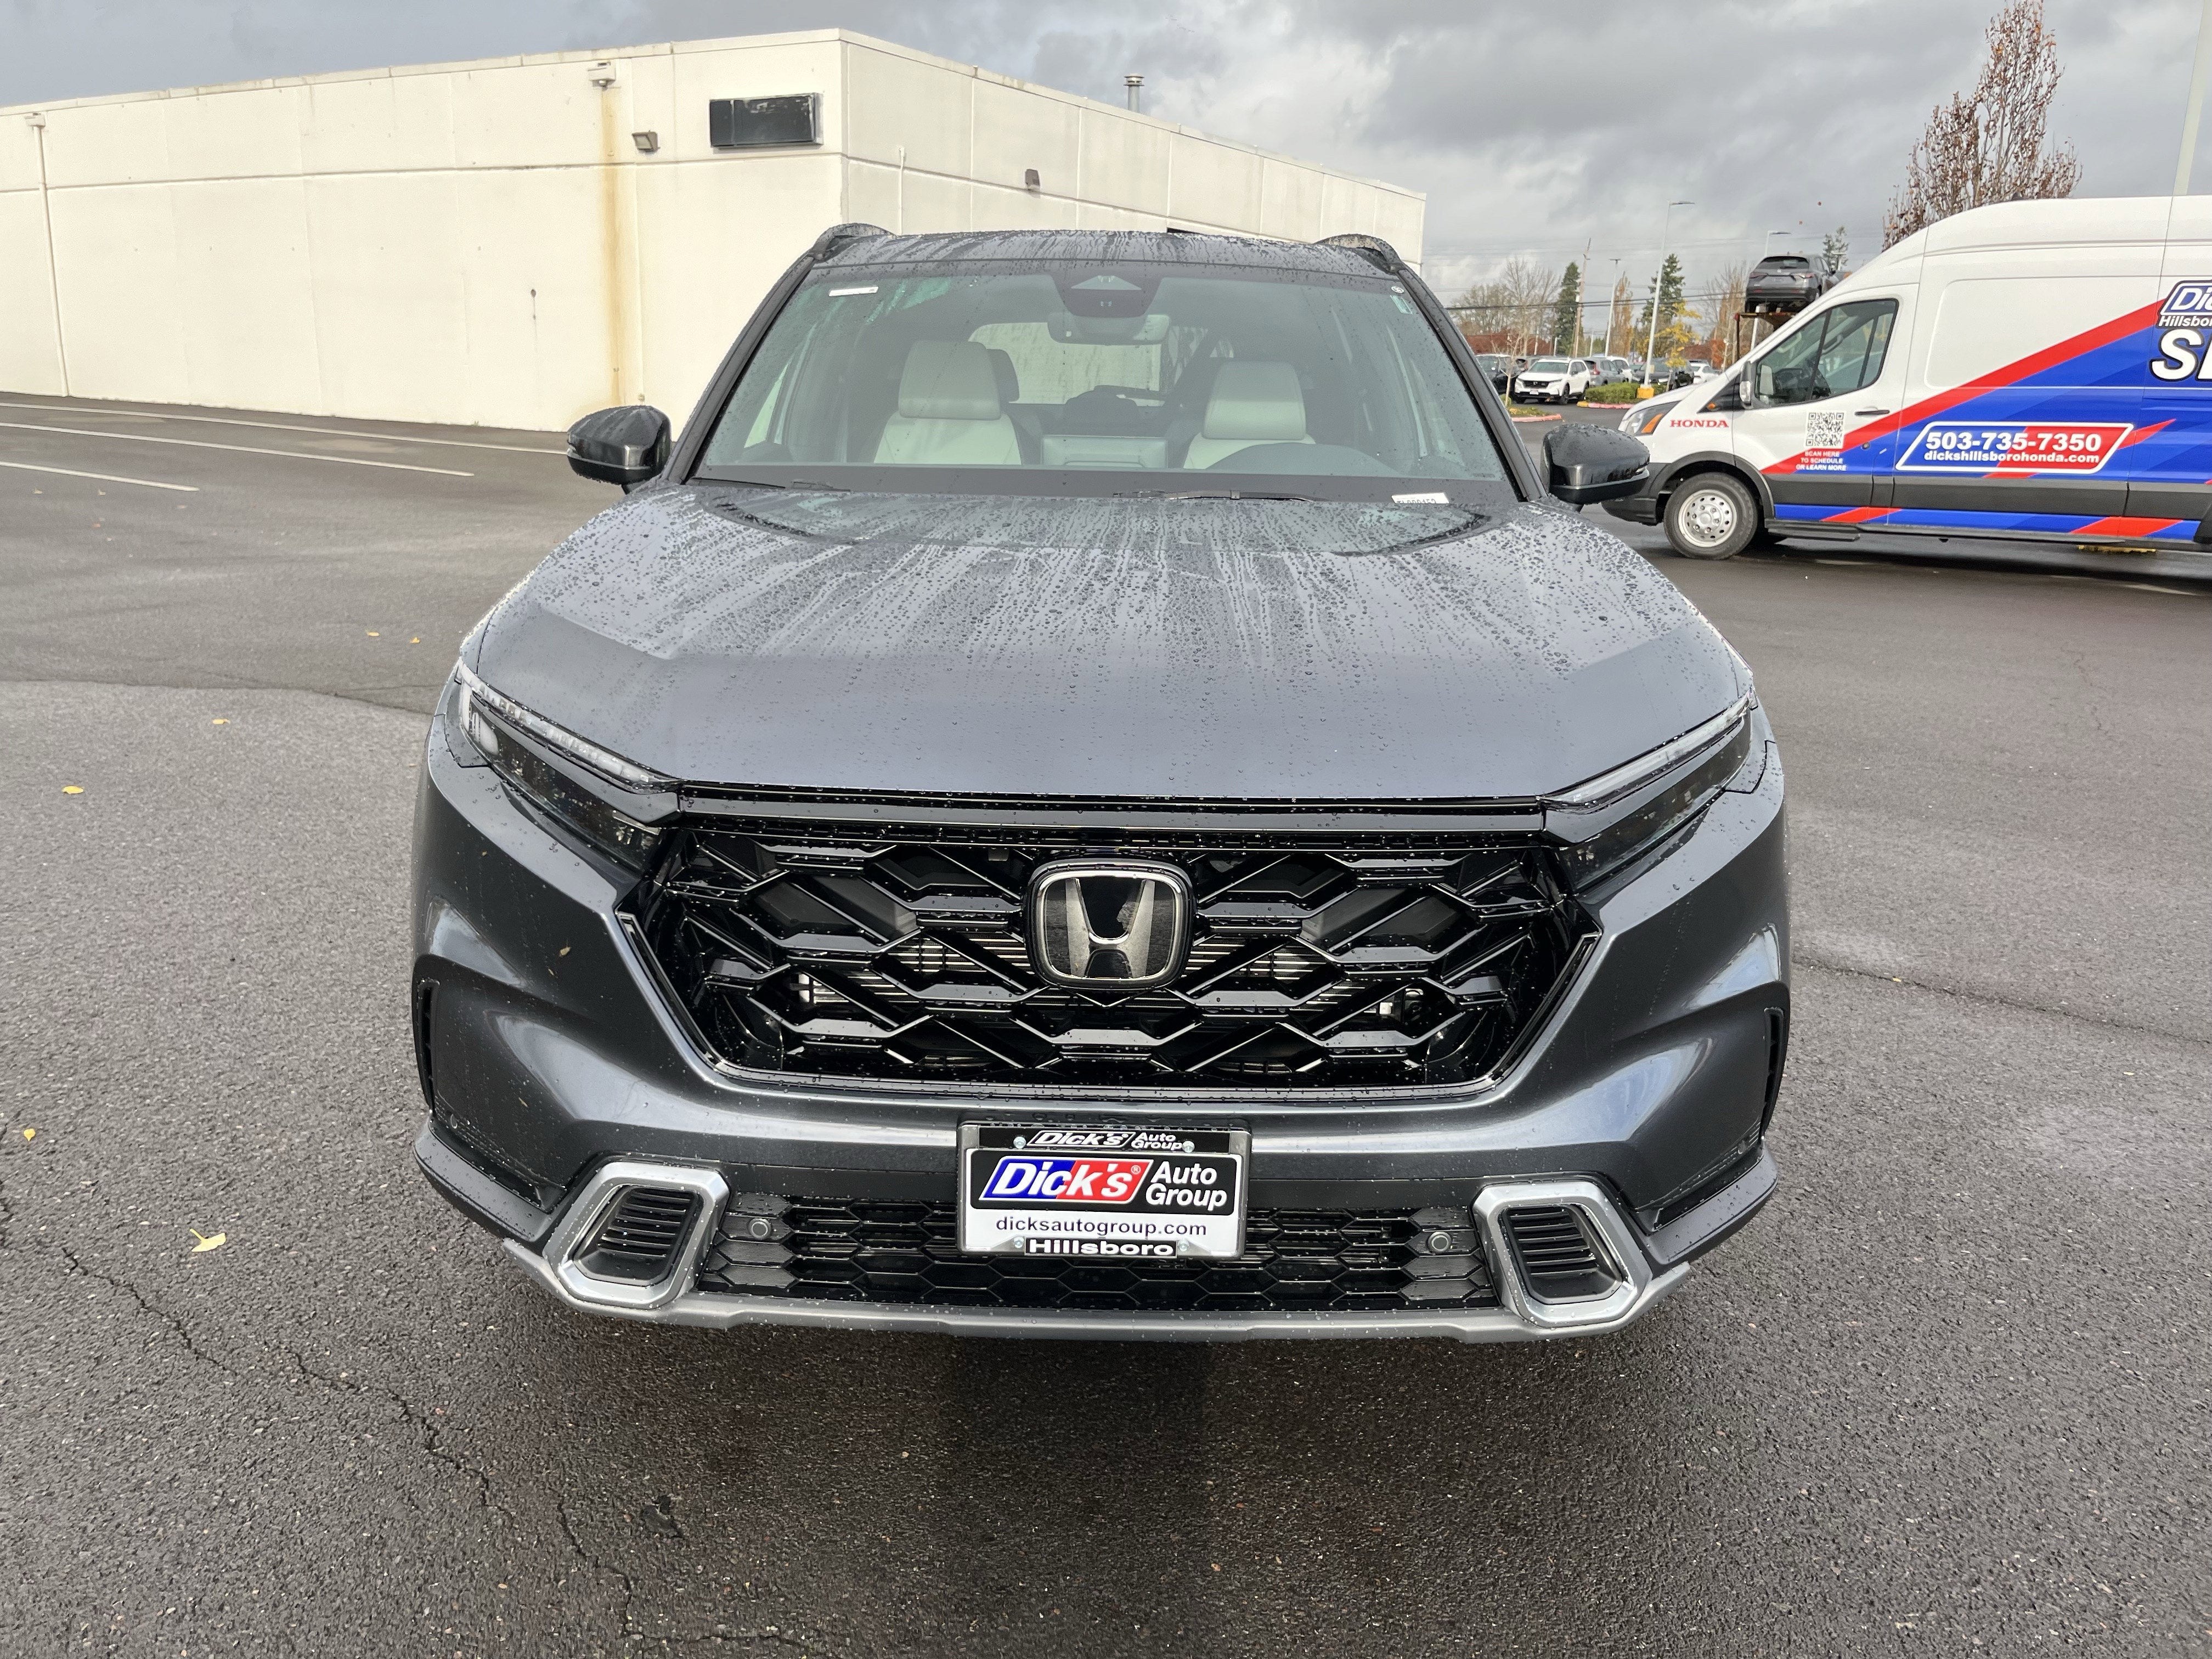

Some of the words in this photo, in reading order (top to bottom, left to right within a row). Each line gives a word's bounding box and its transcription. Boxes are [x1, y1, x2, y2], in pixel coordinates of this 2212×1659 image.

[2158, 315, 2212, 327] Hillsbo
[1669, 419, 1729, 428] HONDA
[1925, 432, 2102, 452] 503-735-7350
[1924, 450, 2100, 463] dickshillsborohonda.com
[1134, 1132, 1176, 1142] Auto
[1131, 1139, 1183, 1151] Group
[1150, 1161, 1217, 1186] Auto
[1145, 1183, 1227, 1211] Group
[996, 1216, 1207, 1240] dicksautogroup.com
[1029, 1239, 1174, 1256] Hillsboro
